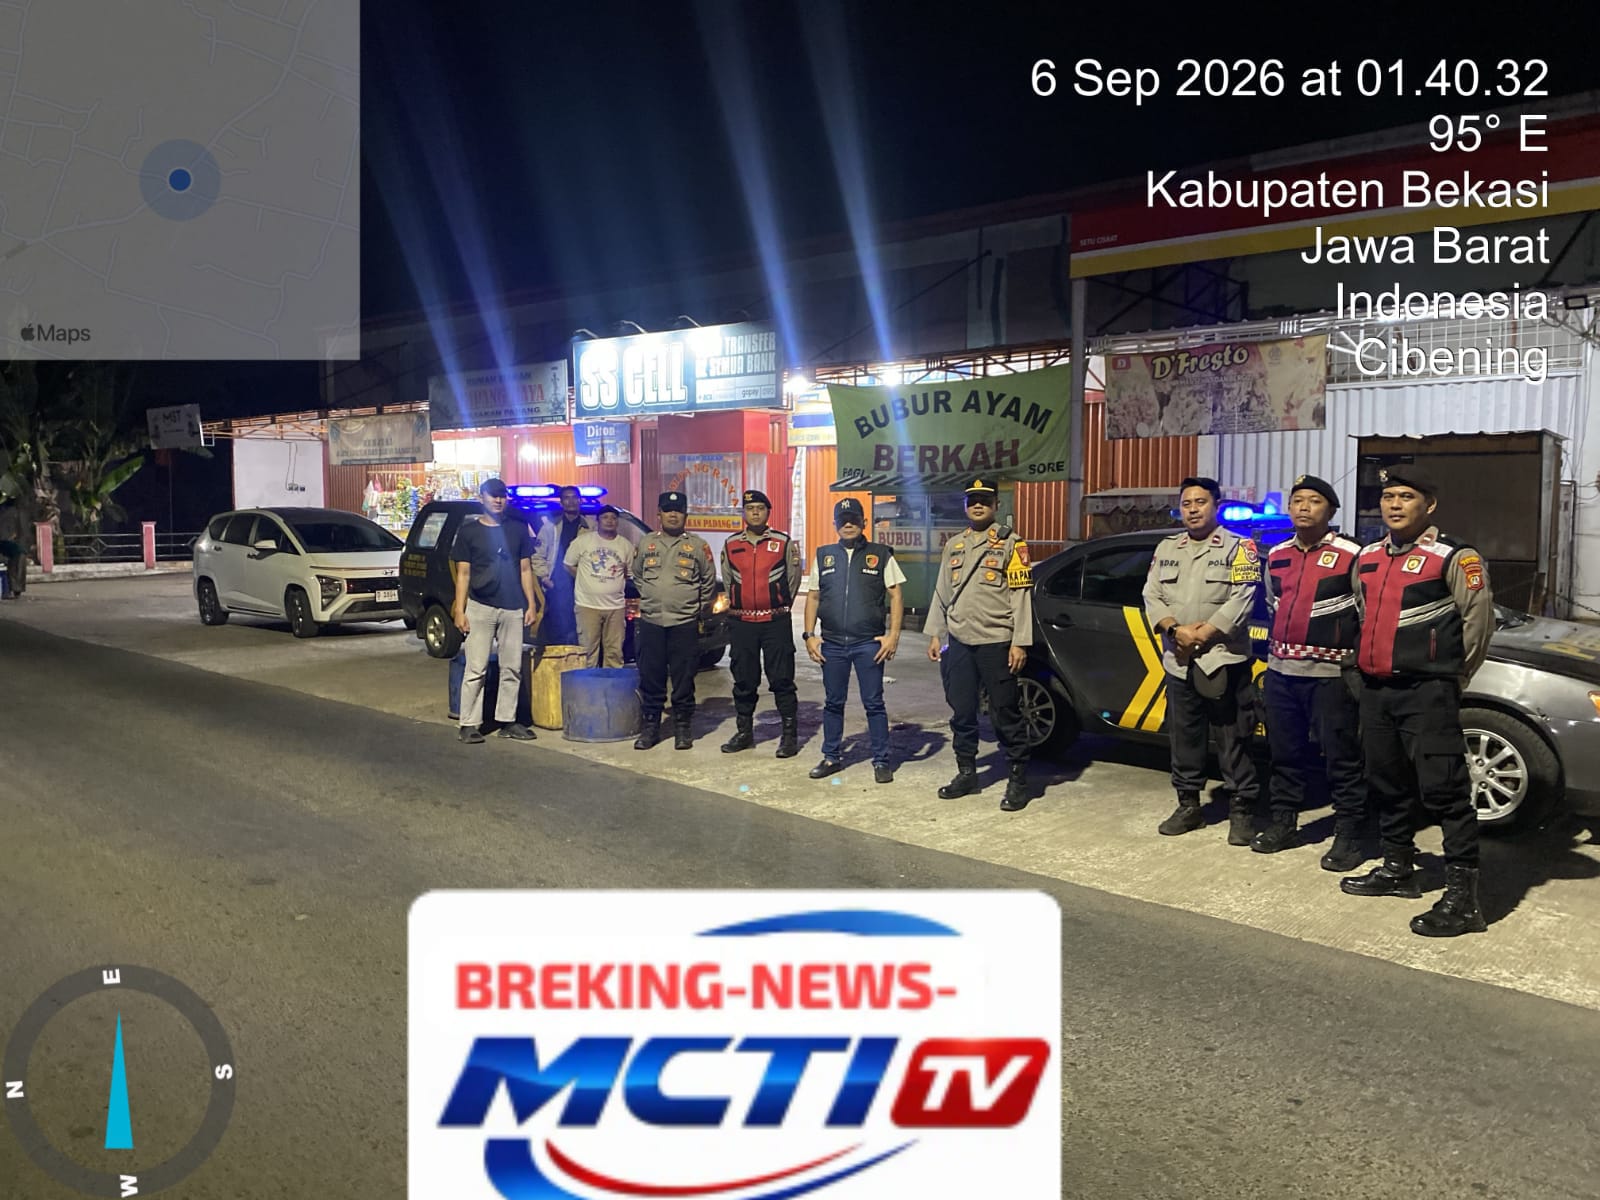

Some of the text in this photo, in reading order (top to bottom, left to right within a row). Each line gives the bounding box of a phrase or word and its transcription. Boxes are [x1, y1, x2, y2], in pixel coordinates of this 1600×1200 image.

[725, 332, 776, 355] TRANSFER
[623, 342, 688, 408] CELL
[747, 352, 776, 373] BANK
[1151, 344, 1249, 380] D'Fresto
[854, 389, 1053, 440] BUBUR AYAM
[873, 438, 1020, 474] BERKAH
[1028, 461, 1065, 475] SORE
[878, 531, 922, 546] BUBUR
